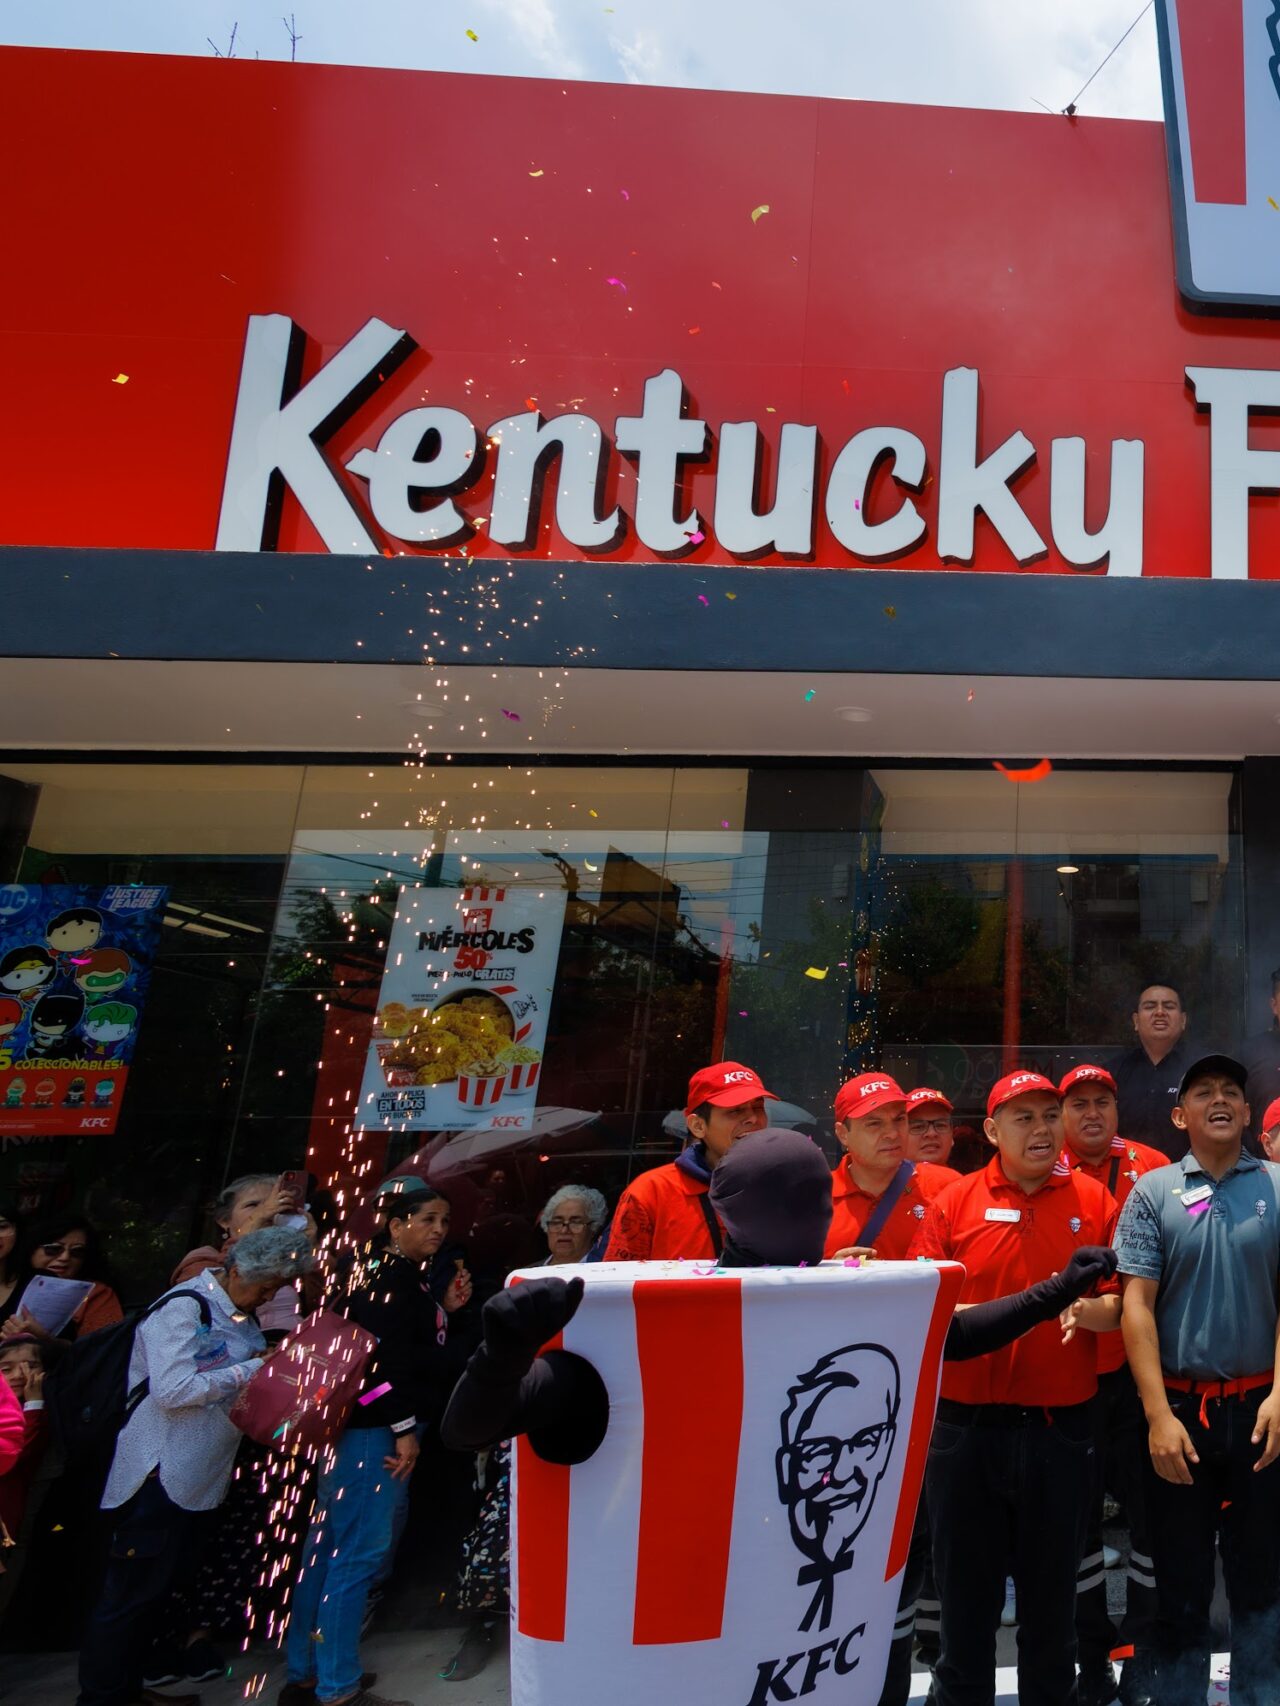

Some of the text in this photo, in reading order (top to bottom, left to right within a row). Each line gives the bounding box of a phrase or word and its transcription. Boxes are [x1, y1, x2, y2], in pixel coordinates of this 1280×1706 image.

[215, 313, 1144, 577] Kentucky
[107, 887, 162, 899] JUSTICE
[108, 898, 155, 911] LEAGUE
[418, 926, 535, 953] MIÉRCOLES
[474, 969, 515, 980] GRATIS
[724, 1071, 754, 1084] KFC
[1076, 1067, 1100, 1079] KFC
[1010, 1074, 1041, 1087] KFC
[860, 1080, 891, 1096] KFC
[911, 1091, 936, 1101] KFC
[80, 1117, 110, 1128] KFC
[491, 1116, 525, 1127] KFC
[746, 1622, 866, 1706] KFC
